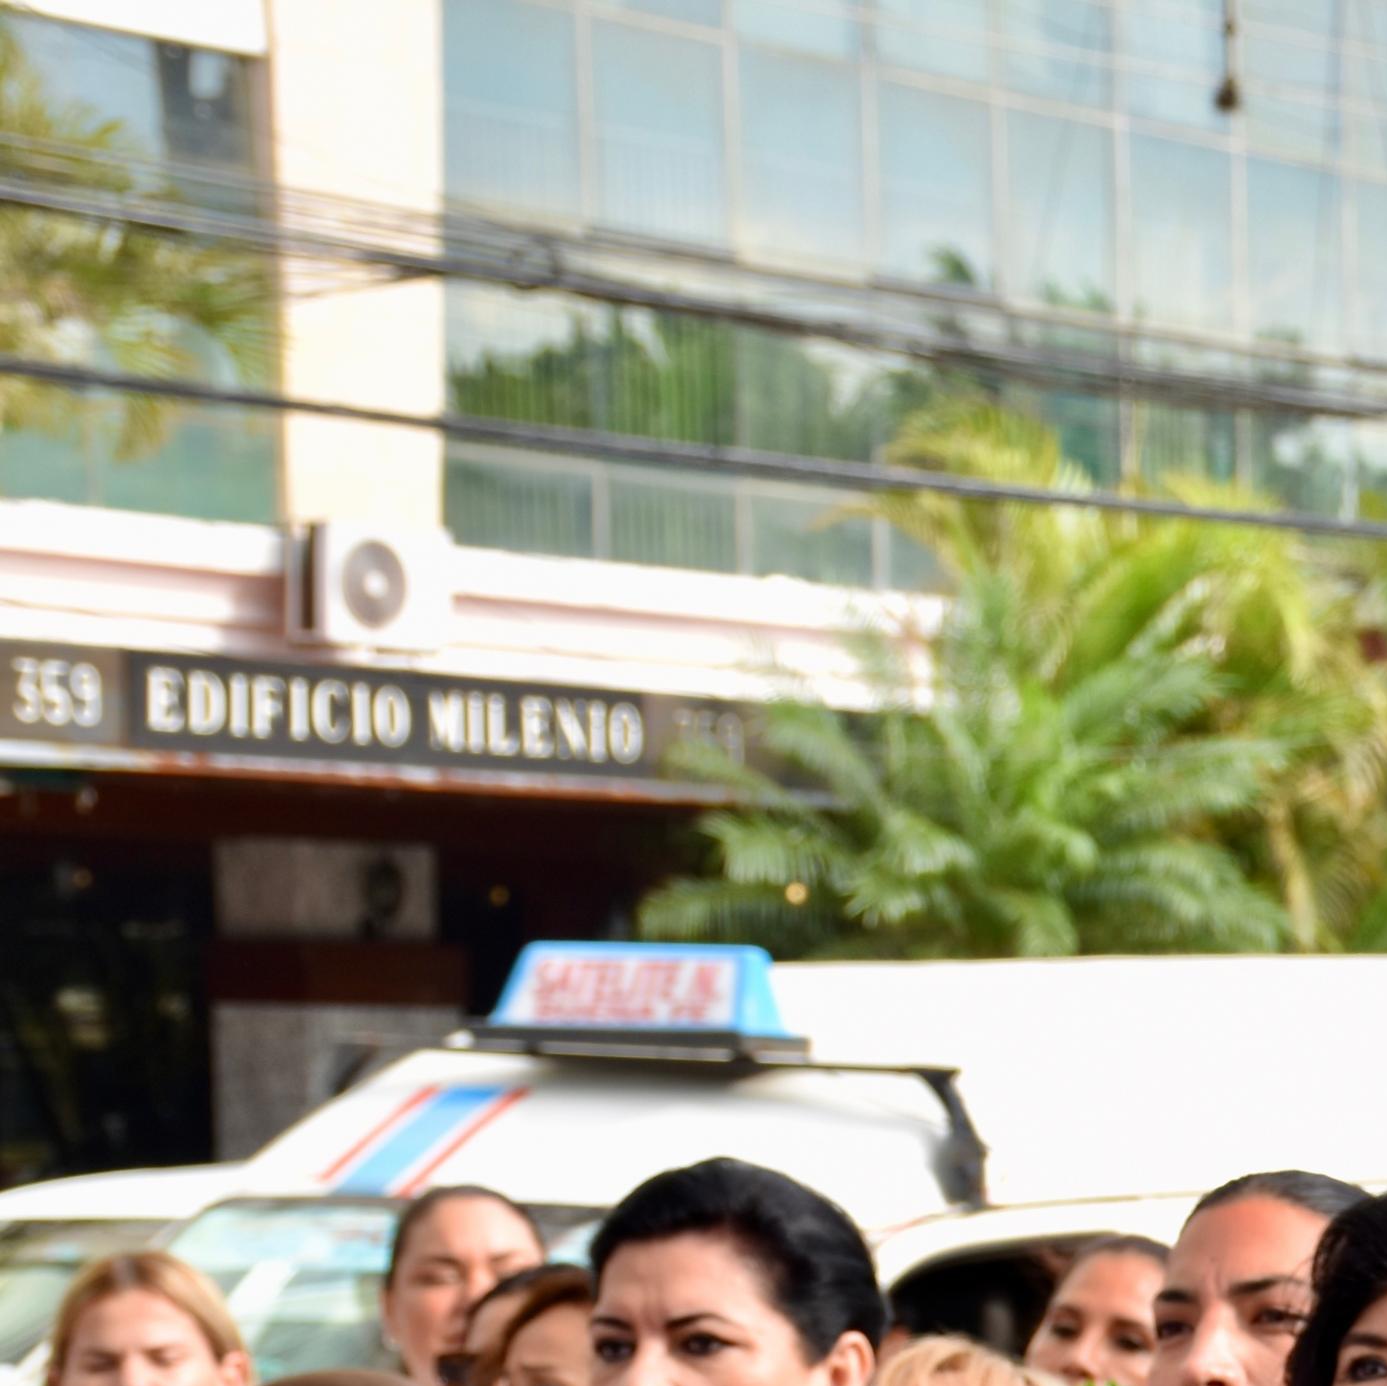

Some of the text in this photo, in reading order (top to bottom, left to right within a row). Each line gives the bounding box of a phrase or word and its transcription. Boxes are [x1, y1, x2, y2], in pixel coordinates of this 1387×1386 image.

[11, 656, 103, 728] 359
[146, 665, 412, 749] EDIFICIO
[427, 688, 645, 765] MILENIO
